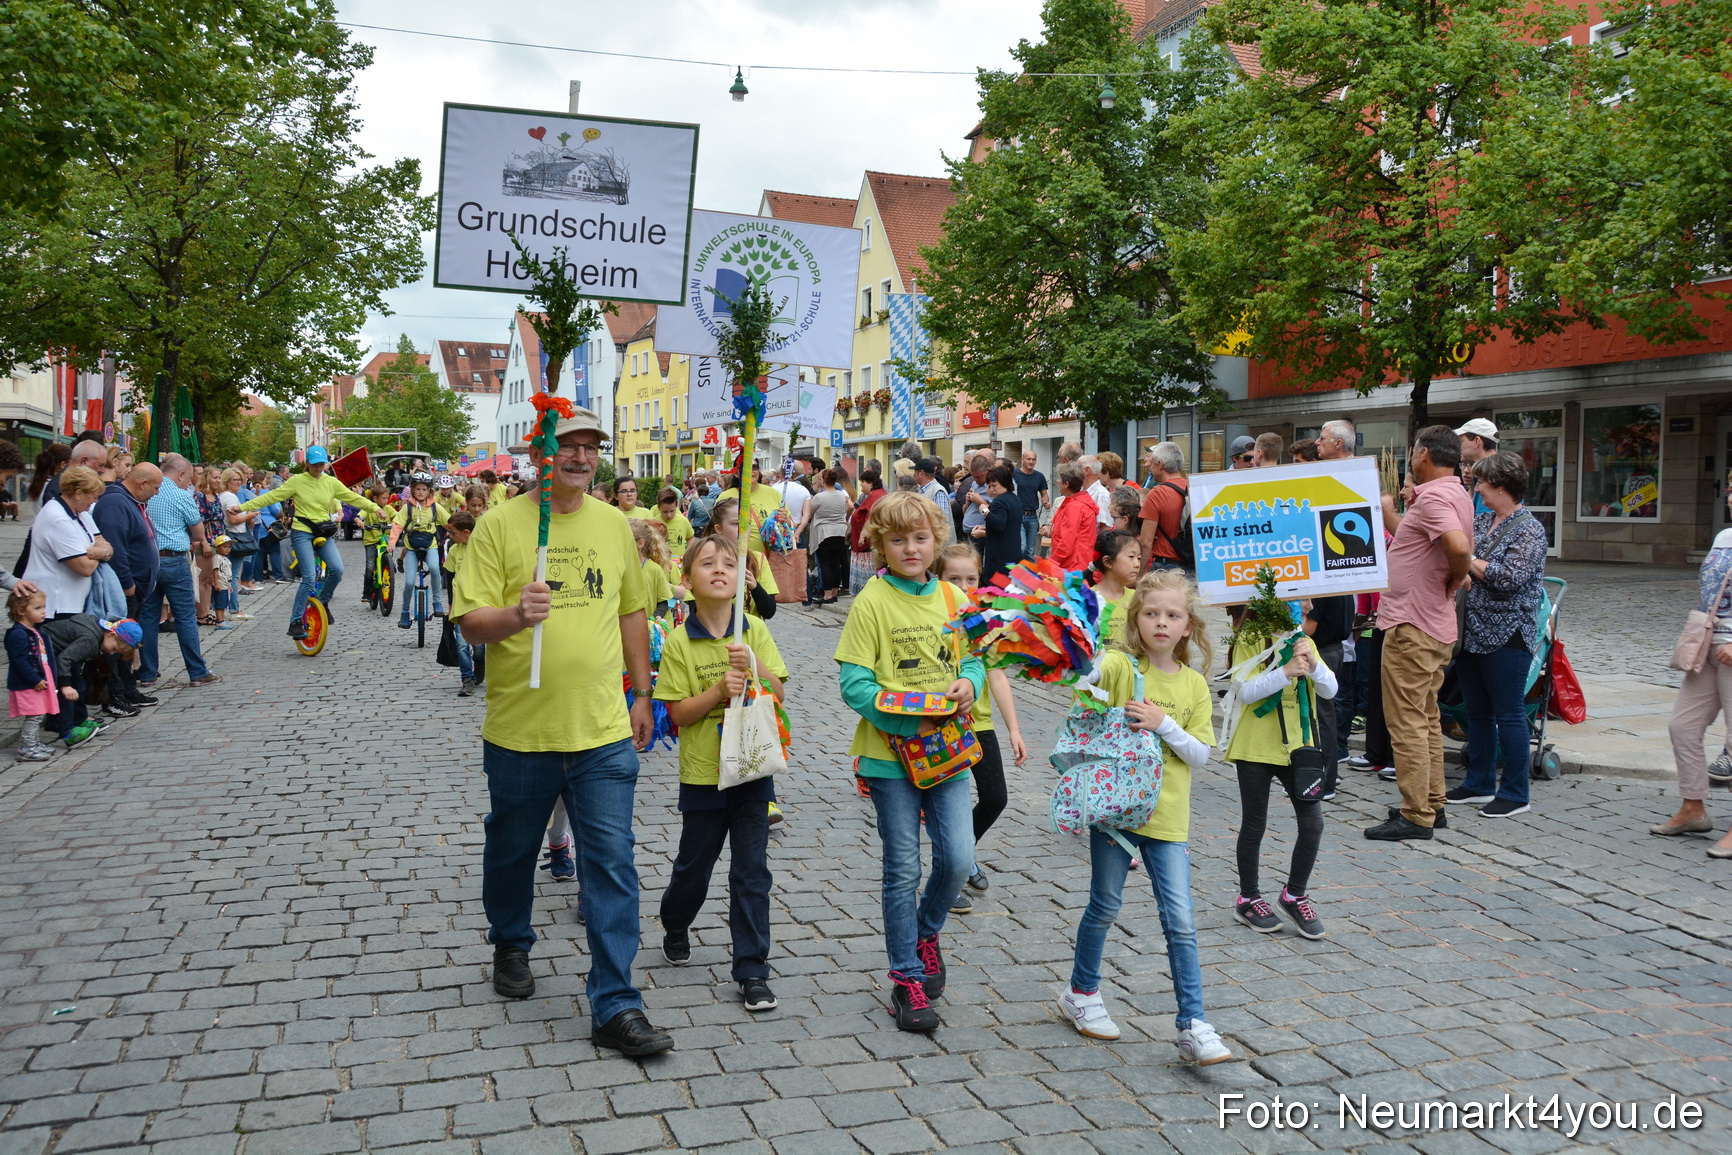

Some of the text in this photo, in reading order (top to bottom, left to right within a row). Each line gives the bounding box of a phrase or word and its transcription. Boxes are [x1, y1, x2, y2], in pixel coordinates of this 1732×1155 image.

[457, 201, 667, 245] Grundschule
[694, 222, 821, 285] UMWELTSCHULE IN EUROPA
[690, 278, 821, 354] INTERNATIO ENDA 21-SCHULE
[1508, 333, 1590, 367] JOSEF
[637, 387, 649, 399] HOTEL
[702, 400, 791, 419] Wir sind CHULE
[1626, 492, 1643, 510] 50%
[1198, 521, 1273, 539] Wir sind
[535, 546, 579, 555] Gndschule
[1199, 535, 1314, 562] Fairtrade
[1326, 556, 1374, 568] FAIRTRADE
[551, 600, 589, 610] mweltschule
[891, 624, 934, 635] Grundschule
[892, 635, 925, 645] Holzheim
[695, 660, 729, 672] Grundschu
[902, 677, 945, 688] Umweltschule
